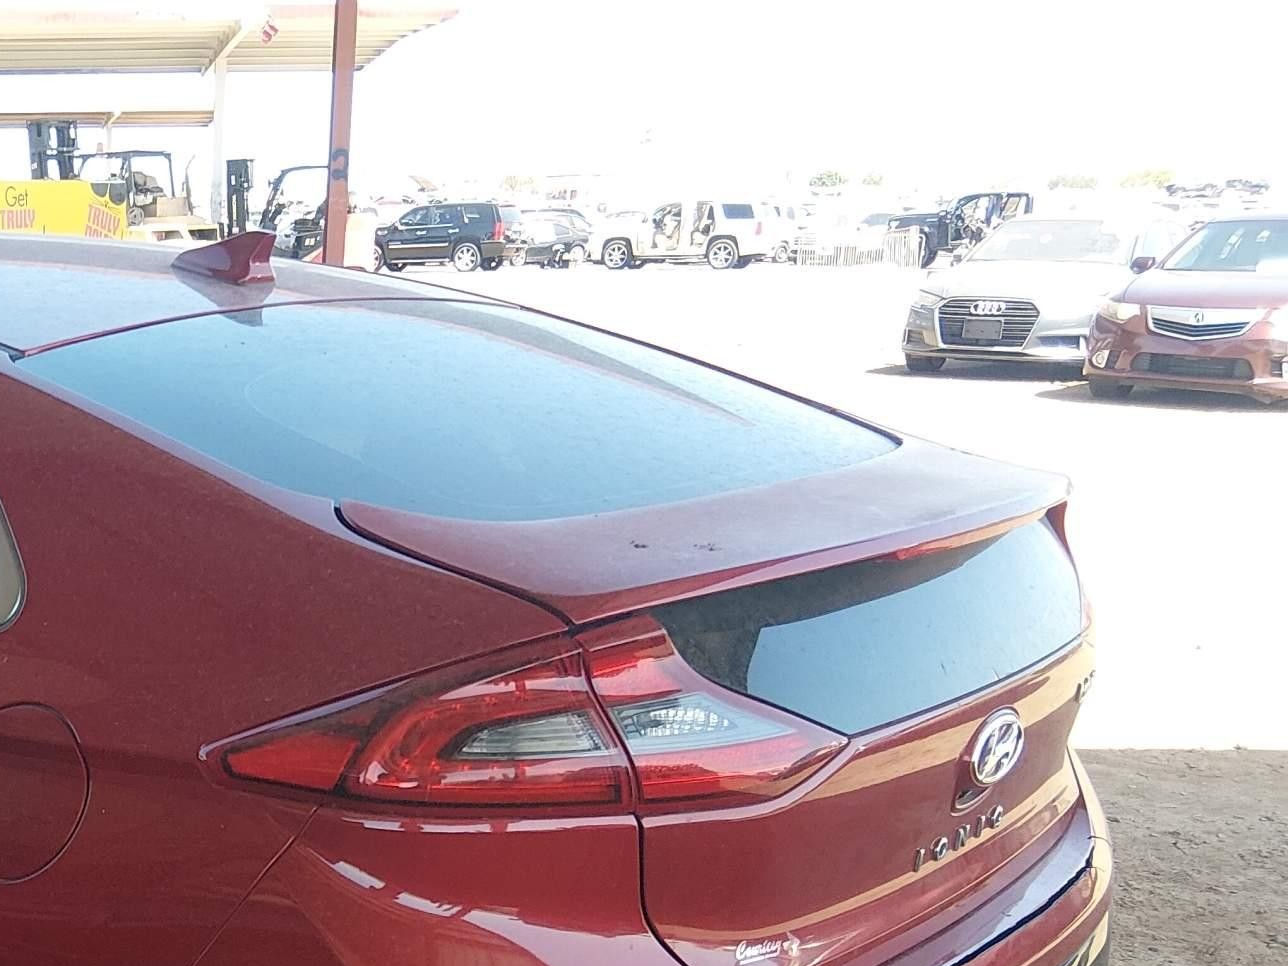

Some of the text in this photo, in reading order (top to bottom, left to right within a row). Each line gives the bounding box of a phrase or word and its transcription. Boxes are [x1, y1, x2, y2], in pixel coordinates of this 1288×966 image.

[5, 186, 29, 207] Get
[0, 209, 36, 231] TRULY
[88, 204, 121, 236] TRULY
